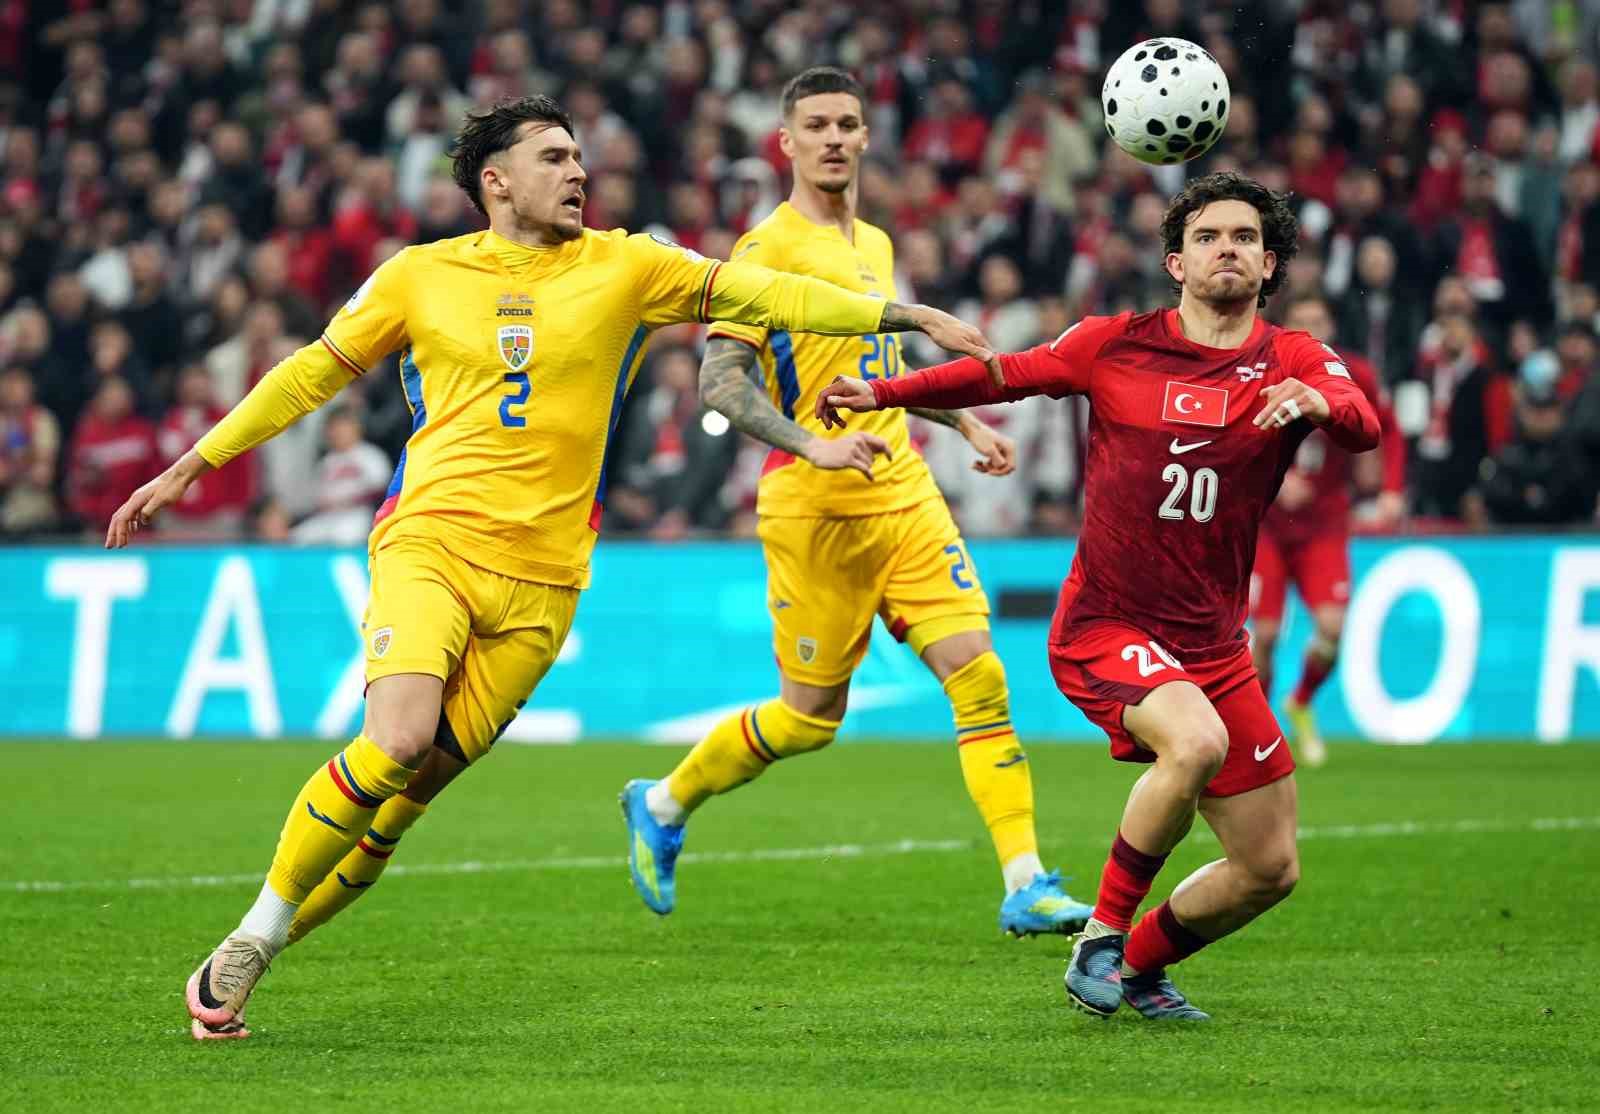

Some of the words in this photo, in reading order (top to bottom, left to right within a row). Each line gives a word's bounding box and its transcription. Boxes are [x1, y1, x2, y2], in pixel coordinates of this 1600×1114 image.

[859, 334, 898, 381] 20
[498, 371, 531, 427] 2
[1158, 463, 1219, 523] 20
